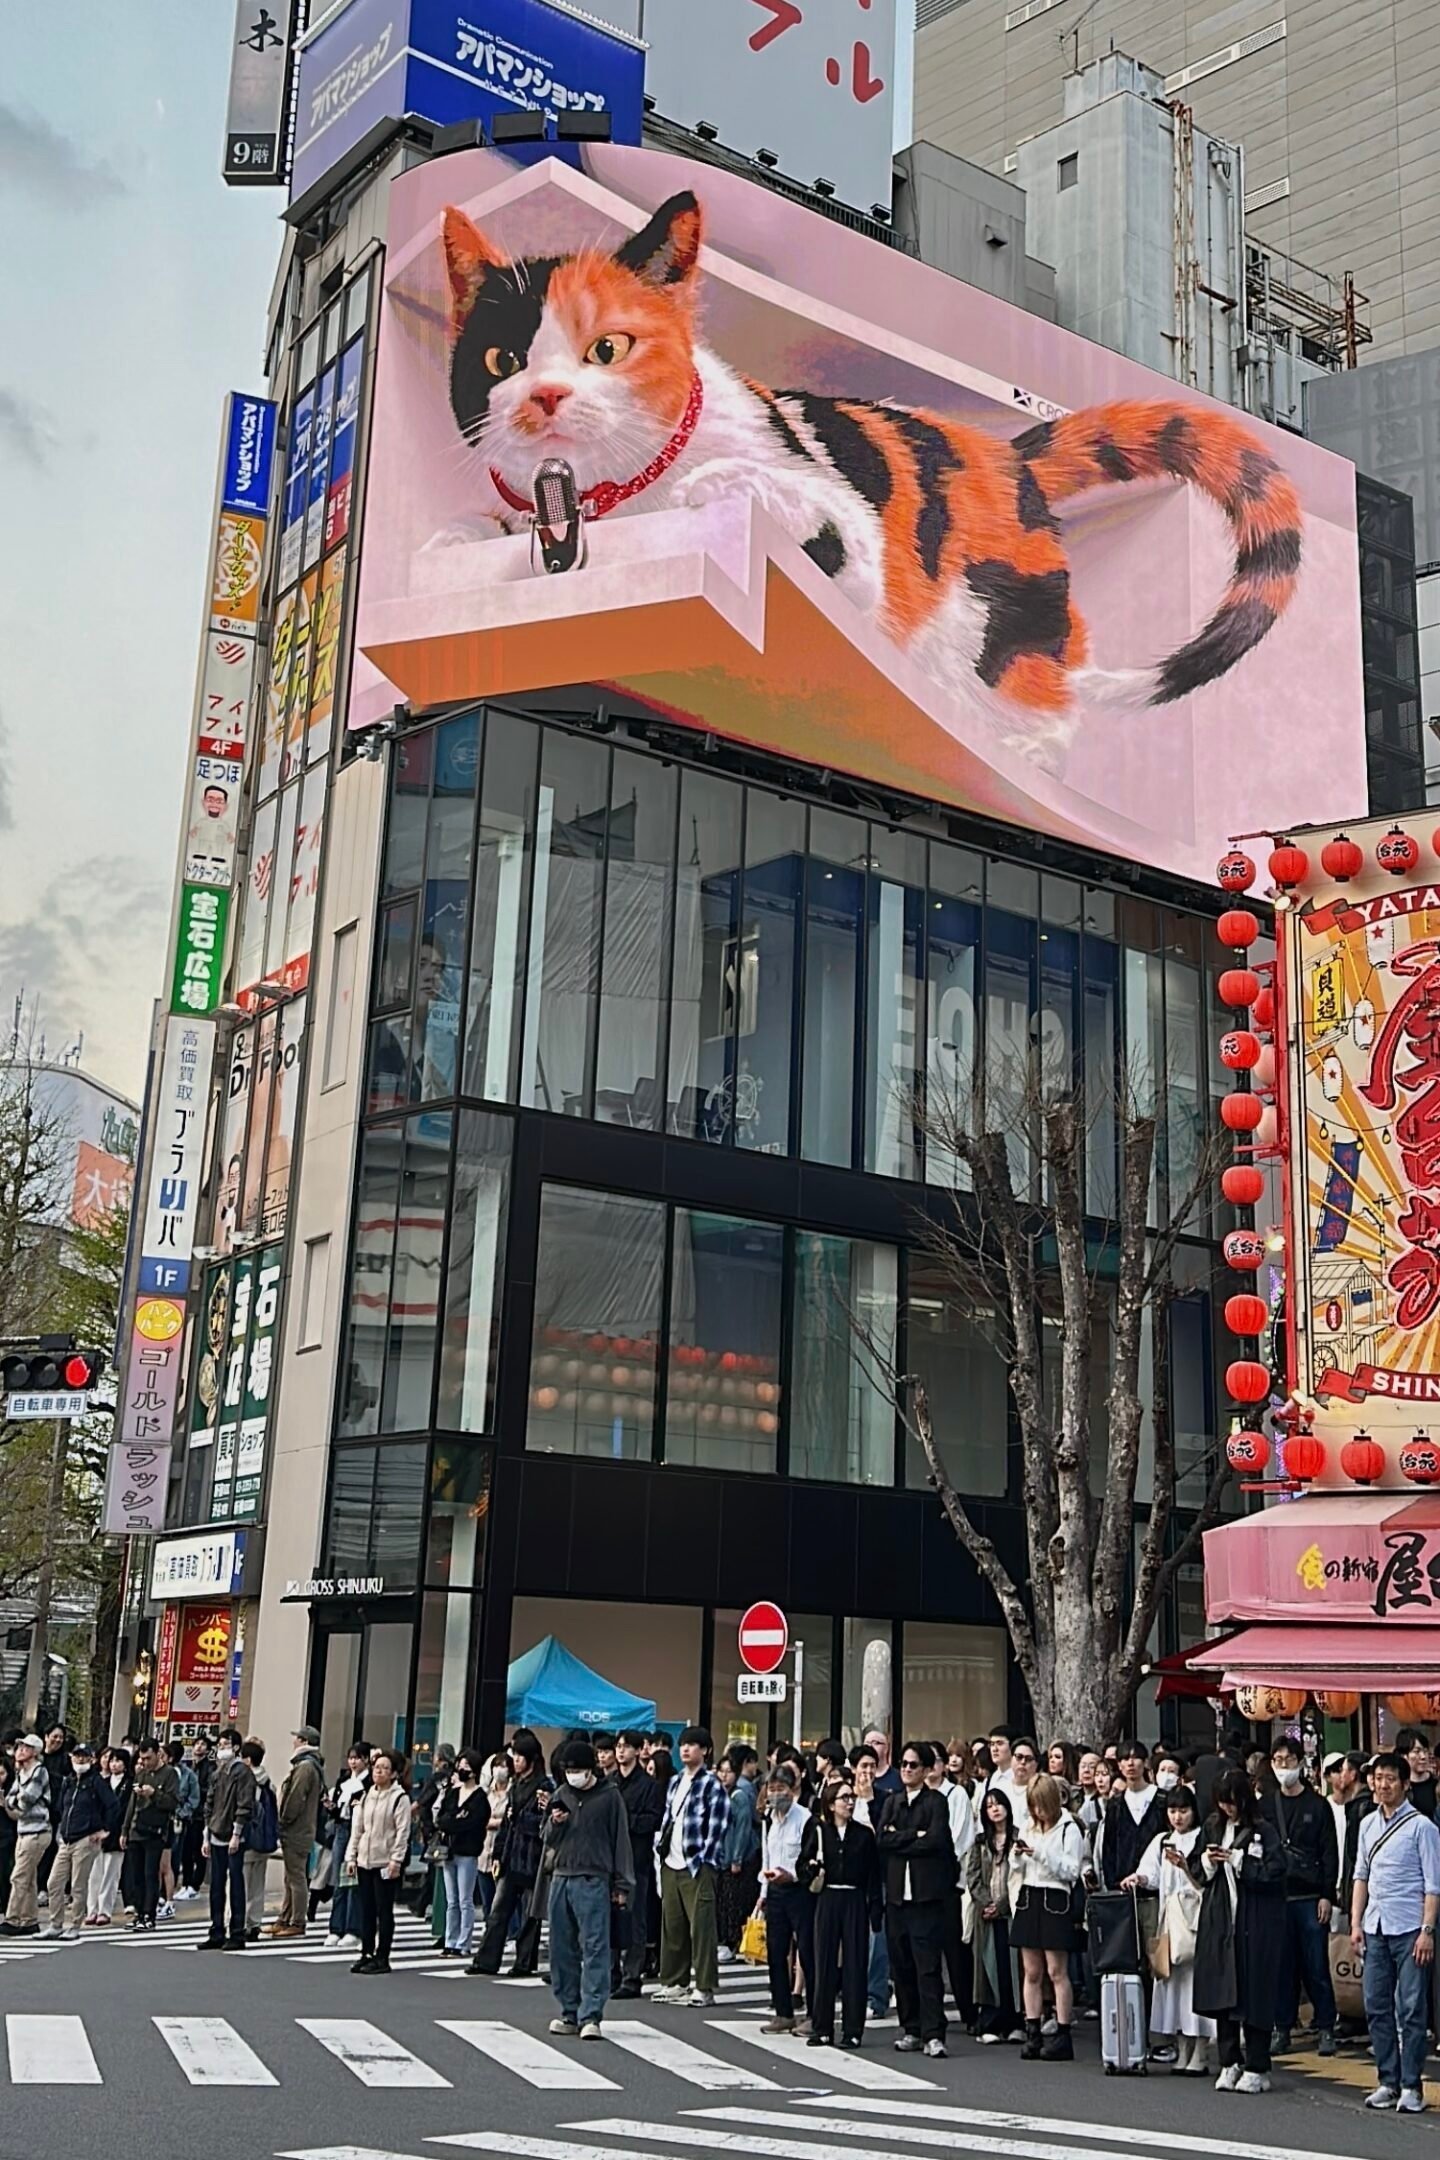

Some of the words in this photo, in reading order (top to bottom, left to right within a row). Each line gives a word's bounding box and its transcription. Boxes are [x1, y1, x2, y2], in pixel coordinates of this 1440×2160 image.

[456, 31, 605, 112] アパマンショップ
[210, 741, 233, 756] 4F
[180, 892, 219, 1011] 宝石広場
[176, 1029, 199, 1101] 高価買取
[157, 1108, 195, 1248] ブラリバ
[153, 1264, 178, 1287] 1F
[13, 1397, 82, 1413] 自転車専用
[121, 1346, 173, 1529] ゴールドラッシュ
[304, 1580, 334, 1596] CROSS
[337, 1577, 384, 1595] SHINJUKU
[578, 1711, 610, 1723] IQOS
